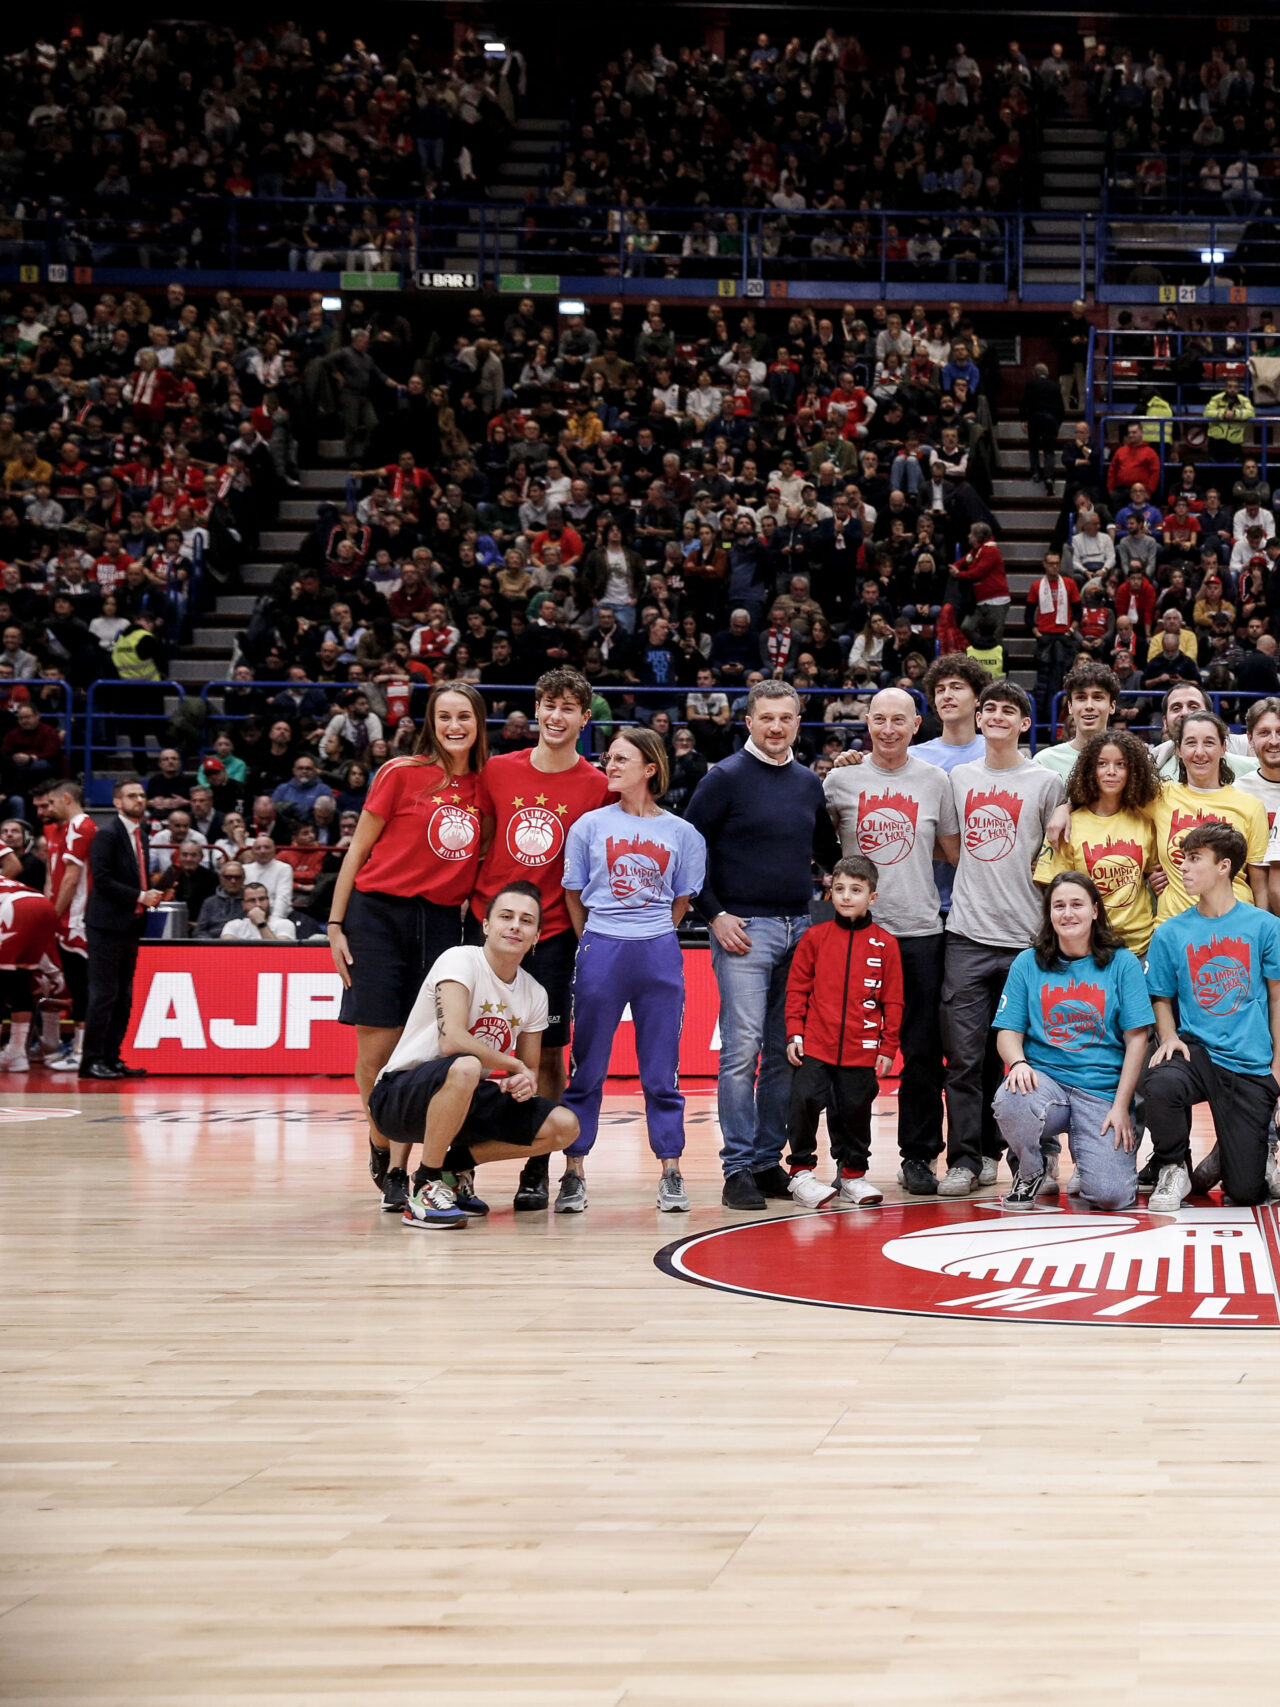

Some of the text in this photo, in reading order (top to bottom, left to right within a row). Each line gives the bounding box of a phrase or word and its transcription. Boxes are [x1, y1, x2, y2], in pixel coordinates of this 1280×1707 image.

[432, 273, 464, 287] BAR
[441, 808, 471, 821] OLIMPIA
[519, 810, 555, 825] OLIMPIA
[437, 846, 467, 858] MILANO
[515, 851, 547, 865] MILANO
